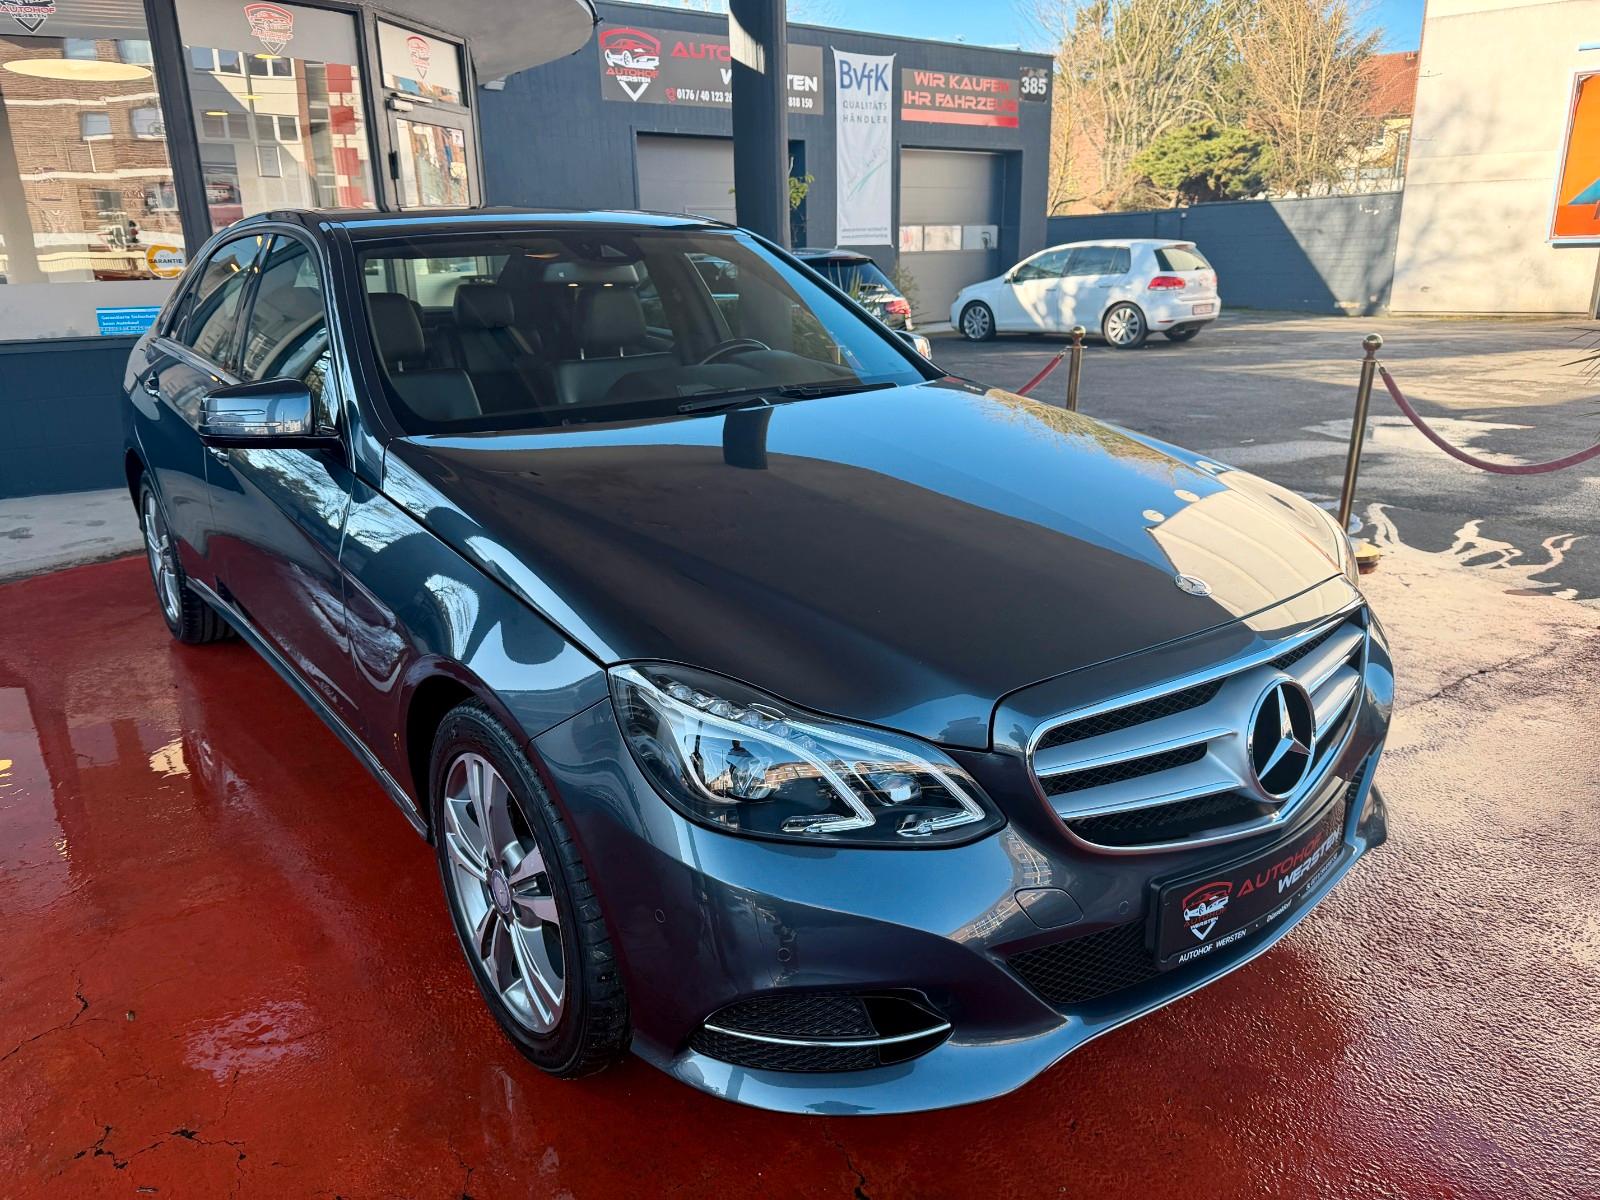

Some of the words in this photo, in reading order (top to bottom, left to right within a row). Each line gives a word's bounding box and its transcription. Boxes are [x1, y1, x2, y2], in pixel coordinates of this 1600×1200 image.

[671, 41, 733, 62] AUTO
[606, 67, 660, 78] AUTOHOF
[913, 71, 946, 88] WIR
[949, 75, 1010, 93] KAUFEN
[676, 88, 695, 100] 0176
[700, 90, 710, 102] 40
[711, 91, 724, 102] 123
[1020, 76, 1048, 95] 385
[842, 100, 888, 112] QUALITÄTS
[903, 90, 932, 106] IHR
[935, 93, 1018, 113] FAHRZEUG
[842, 112, 889, 125] HÄNDLER
[1236, 832, 1324, 898] AUTOHOF
[1278, 825, 1341, 893] WERSTEN
[1178, 943, 1214, 964] AUTOHOF
[1215, 928, 1247, 949] WERSTEN
